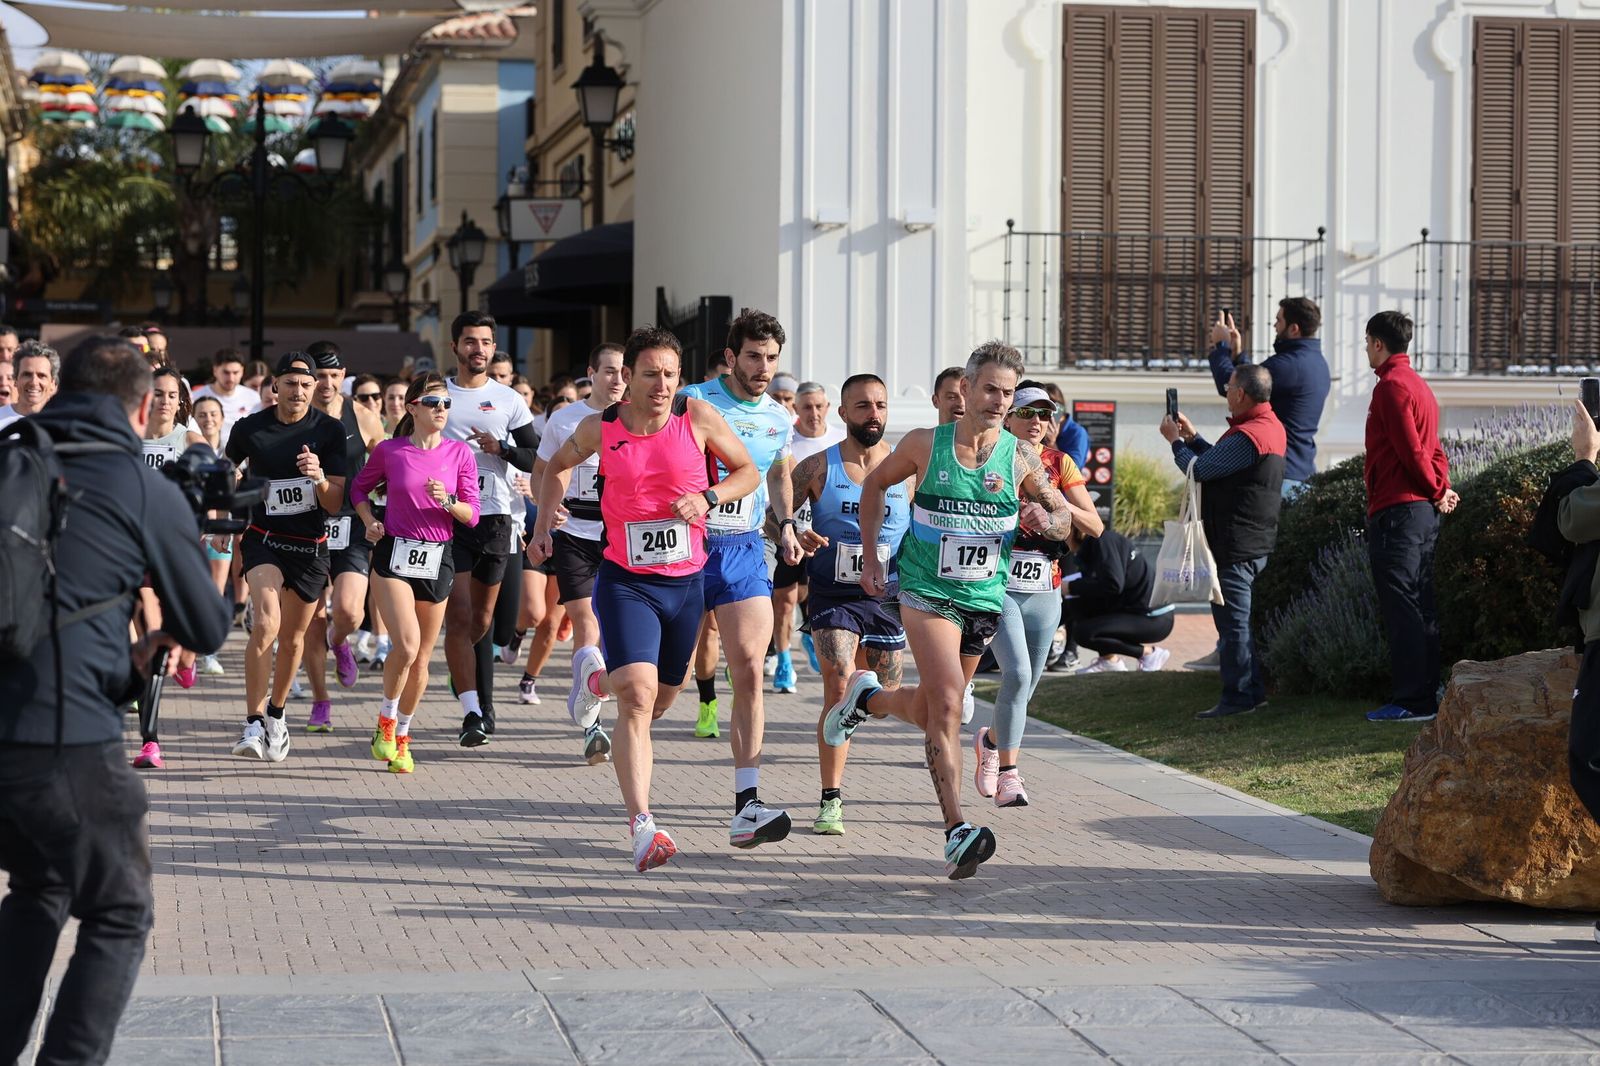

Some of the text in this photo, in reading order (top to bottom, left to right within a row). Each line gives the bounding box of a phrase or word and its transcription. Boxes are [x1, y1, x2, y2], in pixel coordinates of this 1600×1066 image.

[144, 453, 164, 468] 08
[276, 487, 303, 505] 108
[938, 499, 998, 515] ATLETISMO
[928, 513, 1005, 531] TORREMOLINOS
[267, 539, 315, 554] WONG
[642, 528, 677, 552] 240
[408, 549, 428, 567] 84
[957, 546, 988, 566] 179
[1012, 561, 1042, 580] 425
